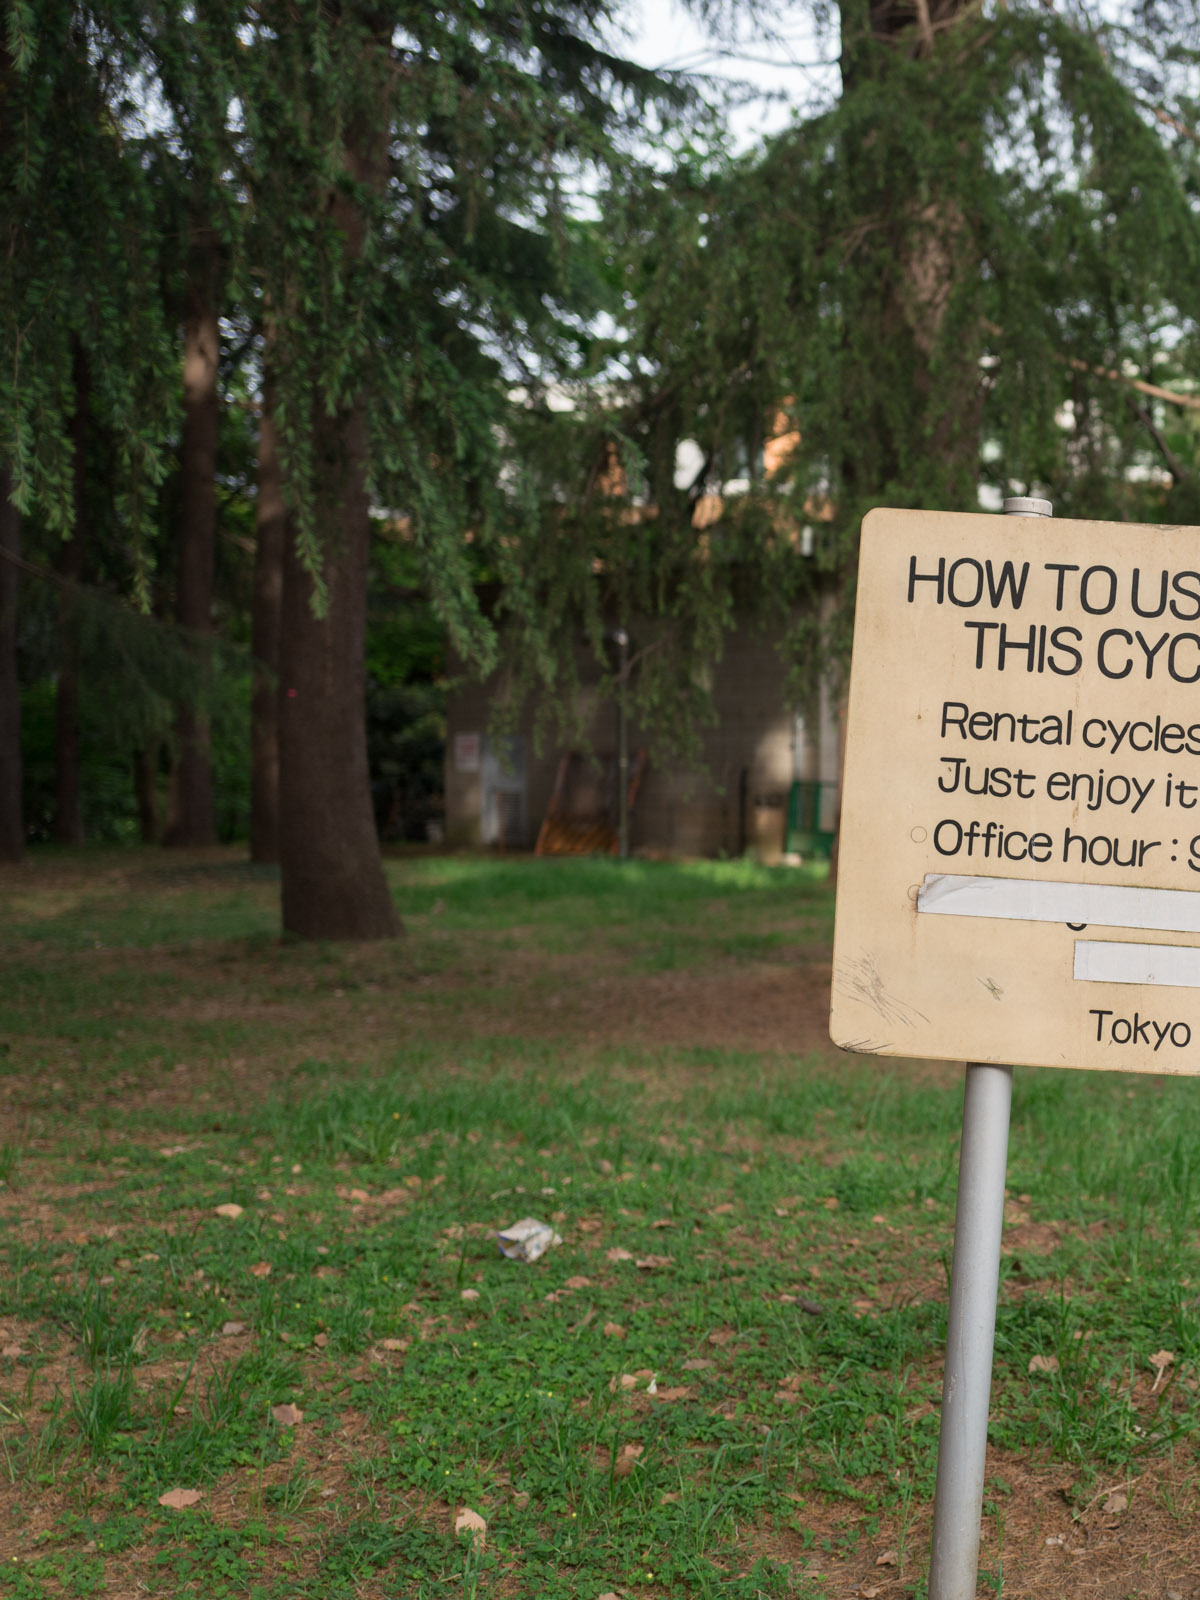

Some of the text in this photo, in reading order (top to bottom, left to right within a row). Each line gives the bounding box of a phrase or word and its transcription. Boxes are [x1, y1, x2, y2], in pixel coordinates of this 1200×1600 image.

[908, 556, 1030, 610] HOW
[1045, 564, 1117, 616] TO
[965, 621, 1082, 676] THIS
[941, 702, 1072, 750] Rental
[938, 757, 1036, 799] Just
[1047, 769, 1154, 814] enjoy
[934, 820, 1052, 864] Office
[1089, 1010, 1191, 1052] Tokyo
